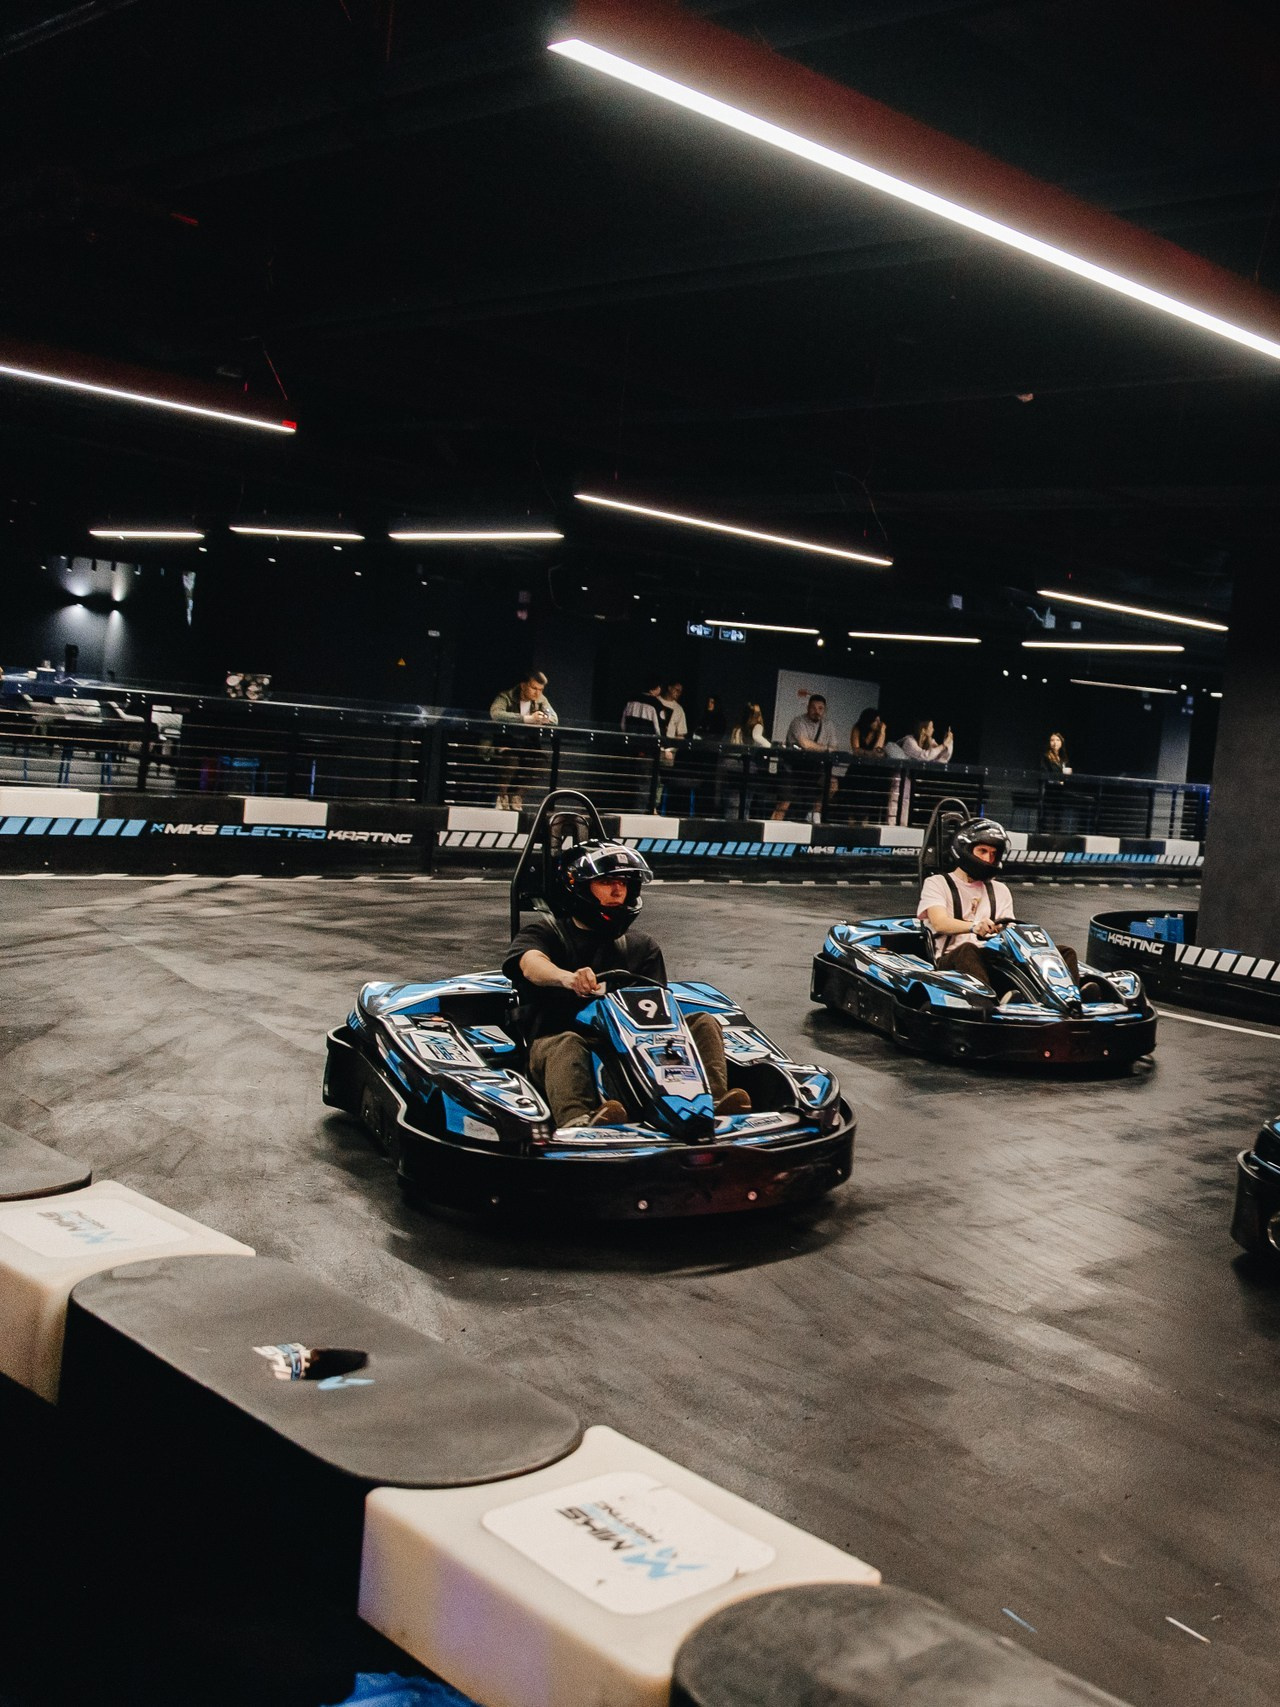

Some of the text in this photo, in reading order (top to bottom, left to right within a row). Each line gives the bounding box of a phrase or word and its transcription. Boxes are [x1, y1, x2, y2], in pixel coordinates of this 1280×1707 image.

[164, 824, 413, 844] MIKS ELECTRO KARTING
[1024, 931, 1047, 944] 13
[1108, 932, 1165, 955] KARTING
[638, 999, 658, 1019] 9
